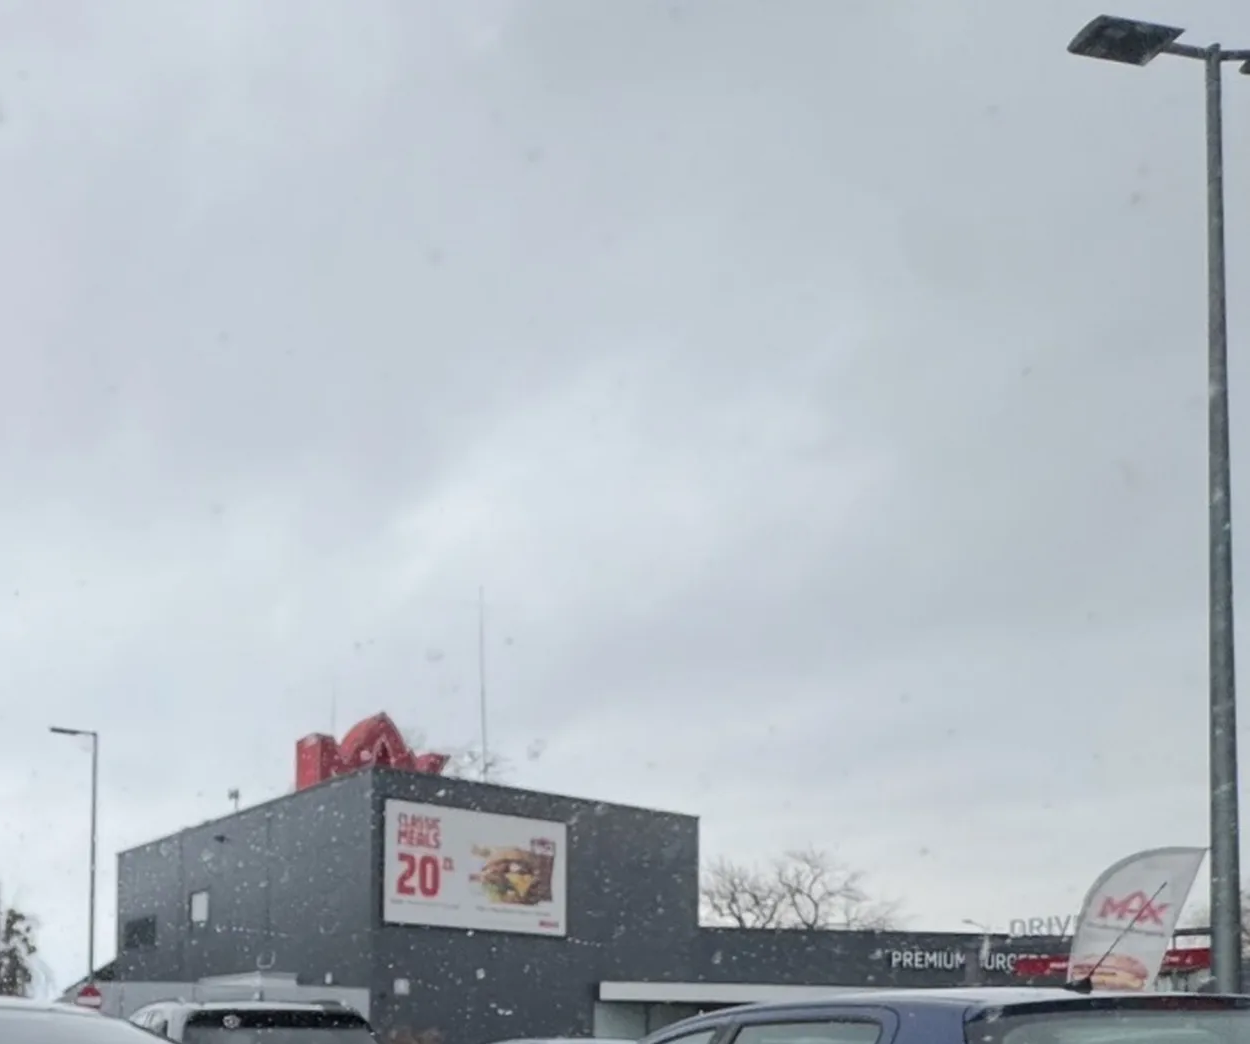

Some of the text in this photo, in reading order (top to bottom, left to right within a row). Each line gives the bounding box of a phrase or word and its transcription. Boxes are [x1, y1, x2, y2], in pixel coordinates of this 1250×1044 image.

[397, 852, 440, 897] 20
[1009, 914, 1080, 937] DRIV
[891, 951, 966, 969] PREMIUM
